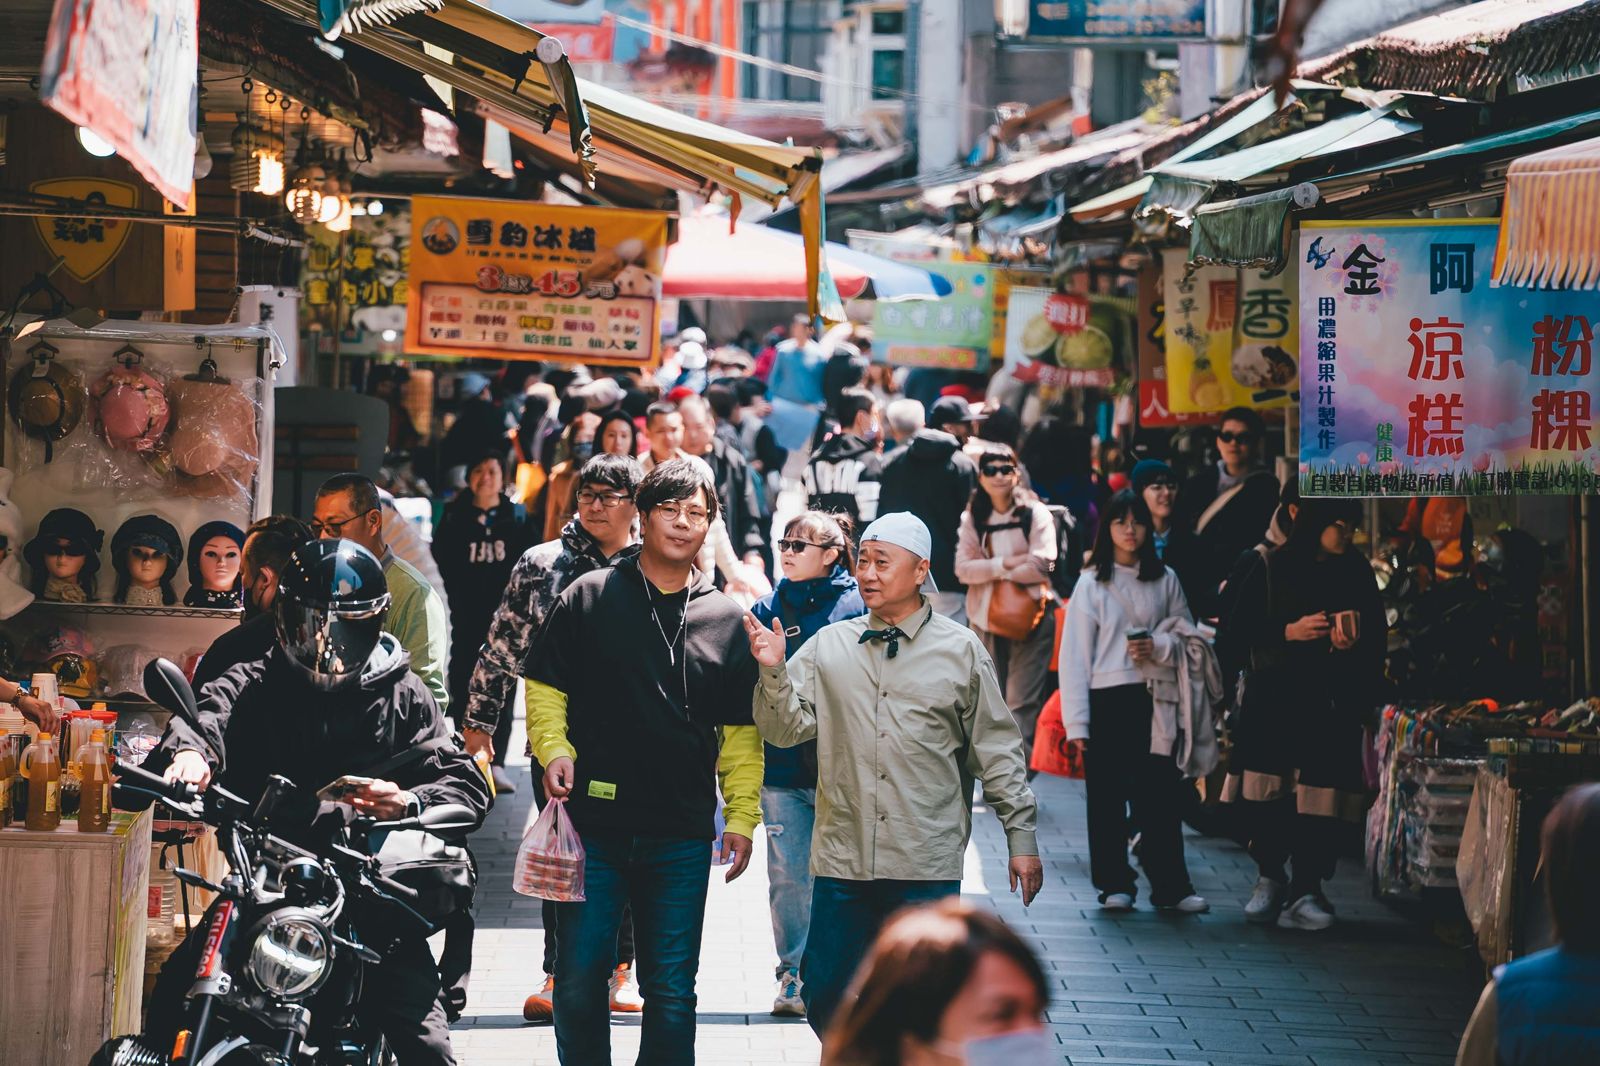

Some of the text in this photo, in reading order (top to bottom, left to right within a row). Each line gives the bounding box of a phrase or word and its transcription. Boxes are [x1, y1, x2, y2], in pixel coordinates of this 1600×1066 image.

[1343, 244, 1385, 295] 金
[1318, 297, 1336, 450] 用濃縮果汁製作
[1407, 317, 1465, 457] 涼糕
[1531, 315, 1594, 451] 粉粿
[1376, 422, 1393, 463] 健康
